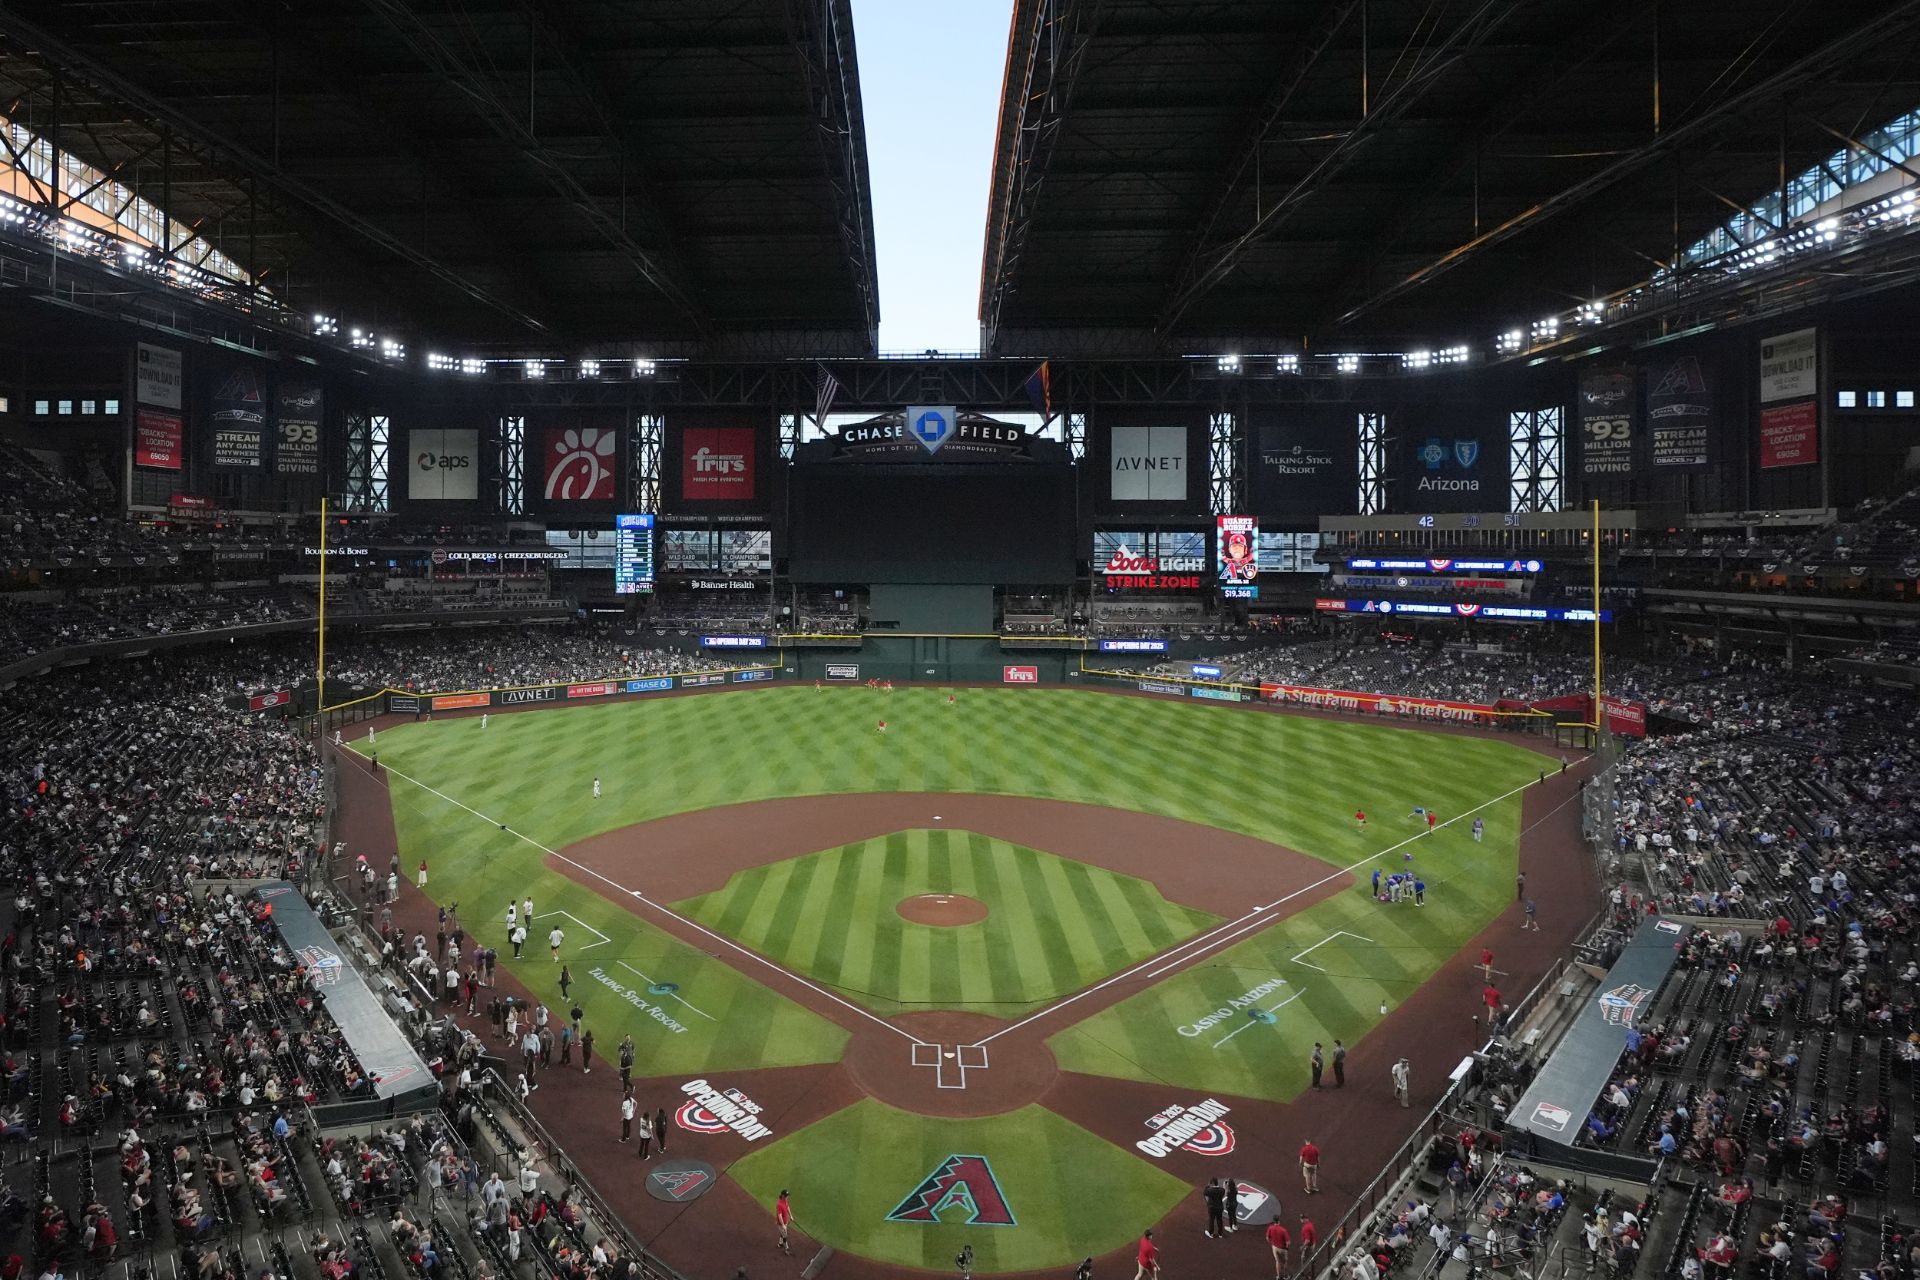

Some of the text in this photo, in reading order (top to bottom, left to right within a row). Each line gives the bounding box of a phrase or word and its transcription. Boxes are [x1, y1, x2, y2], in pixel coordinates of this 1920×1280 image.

[1584, 414, 1631, 422] CELEBRATING
[278, 424, 318, 443] $93
[845, 425, 1019, 442] CHASE FIELD
[1584, 420, 1631, 441] $93
[1653, 429, 1707, 440] STREAM
[145, 438, 174, 448] LOCATION
[215, 433, 260, 443] STREAM
[1654, 438, 1707, 448] ANY GAME
[1769, 433, 1806, 445] LOCATION
[278, 443, 318, 451] MILLION
[944, 445, 998, 453] DIAMONDBACKS
[1584, 440, 1631, 450] MILLION
[215, 449, 260, 457] ANYWHERE
[1654, 447, 1707, 456] ANYWHERE
[438, 454, 469, 471] aps
[691, 447, 745, 474] fry's
[1116, 457, 1182, 471] AVNET
[1262, 455, 1333, 465] TALKING STICK
[277, 464, 318, 473] GIVING
[1279, 464, 1316, 474] RESORT
[1584, 462, 1631, 473] GIVING
[1417, 476, 1480, 492] Arizona
[1418, 516, 1434, 527] 42
[1504, 514, 1521, 526] 51
[338, 547, 346, 555] &
[347, 547, 369, 555] BONES
[472, 552, 497, 560] BEERS
[498, 552, 504, 560] &
[1107, 551, 1205, 572] Coors LIGHT
[700, 580, 755, 589] Banner Health
[1107, 576, 1200, 588] STRIKE ZONE
[1225, 590, 1251, 598] $19,368
[1496, 608, 1520, 616] OPENING
[1521, 609, 1532, 617] DAY
[717, 637, 762, 645] OPENING DAY 2025
[1117, 641, 1139, 649] OPENING
[1150, 642, 1164, 650] 2025
[1008, 668, 1033, 681] fry's
[632, 680, 659, 689] CHASE
[508, 689, 551, 702] AVNET
[1198, 689, 1233, 699] COX COX
[588, 967, 688, 1033] TALKING STICK RESORT
[1177, 978, 1287, 1037] CASINO ARIZONA
[680, 1079, 773, 1142] OPENING DAY
[739, 1099, 764, 1115] 2025
[1162, 1103, 1185, 1119] 2025
[1136, 1098, 1231, 1158] OPENING DAY
